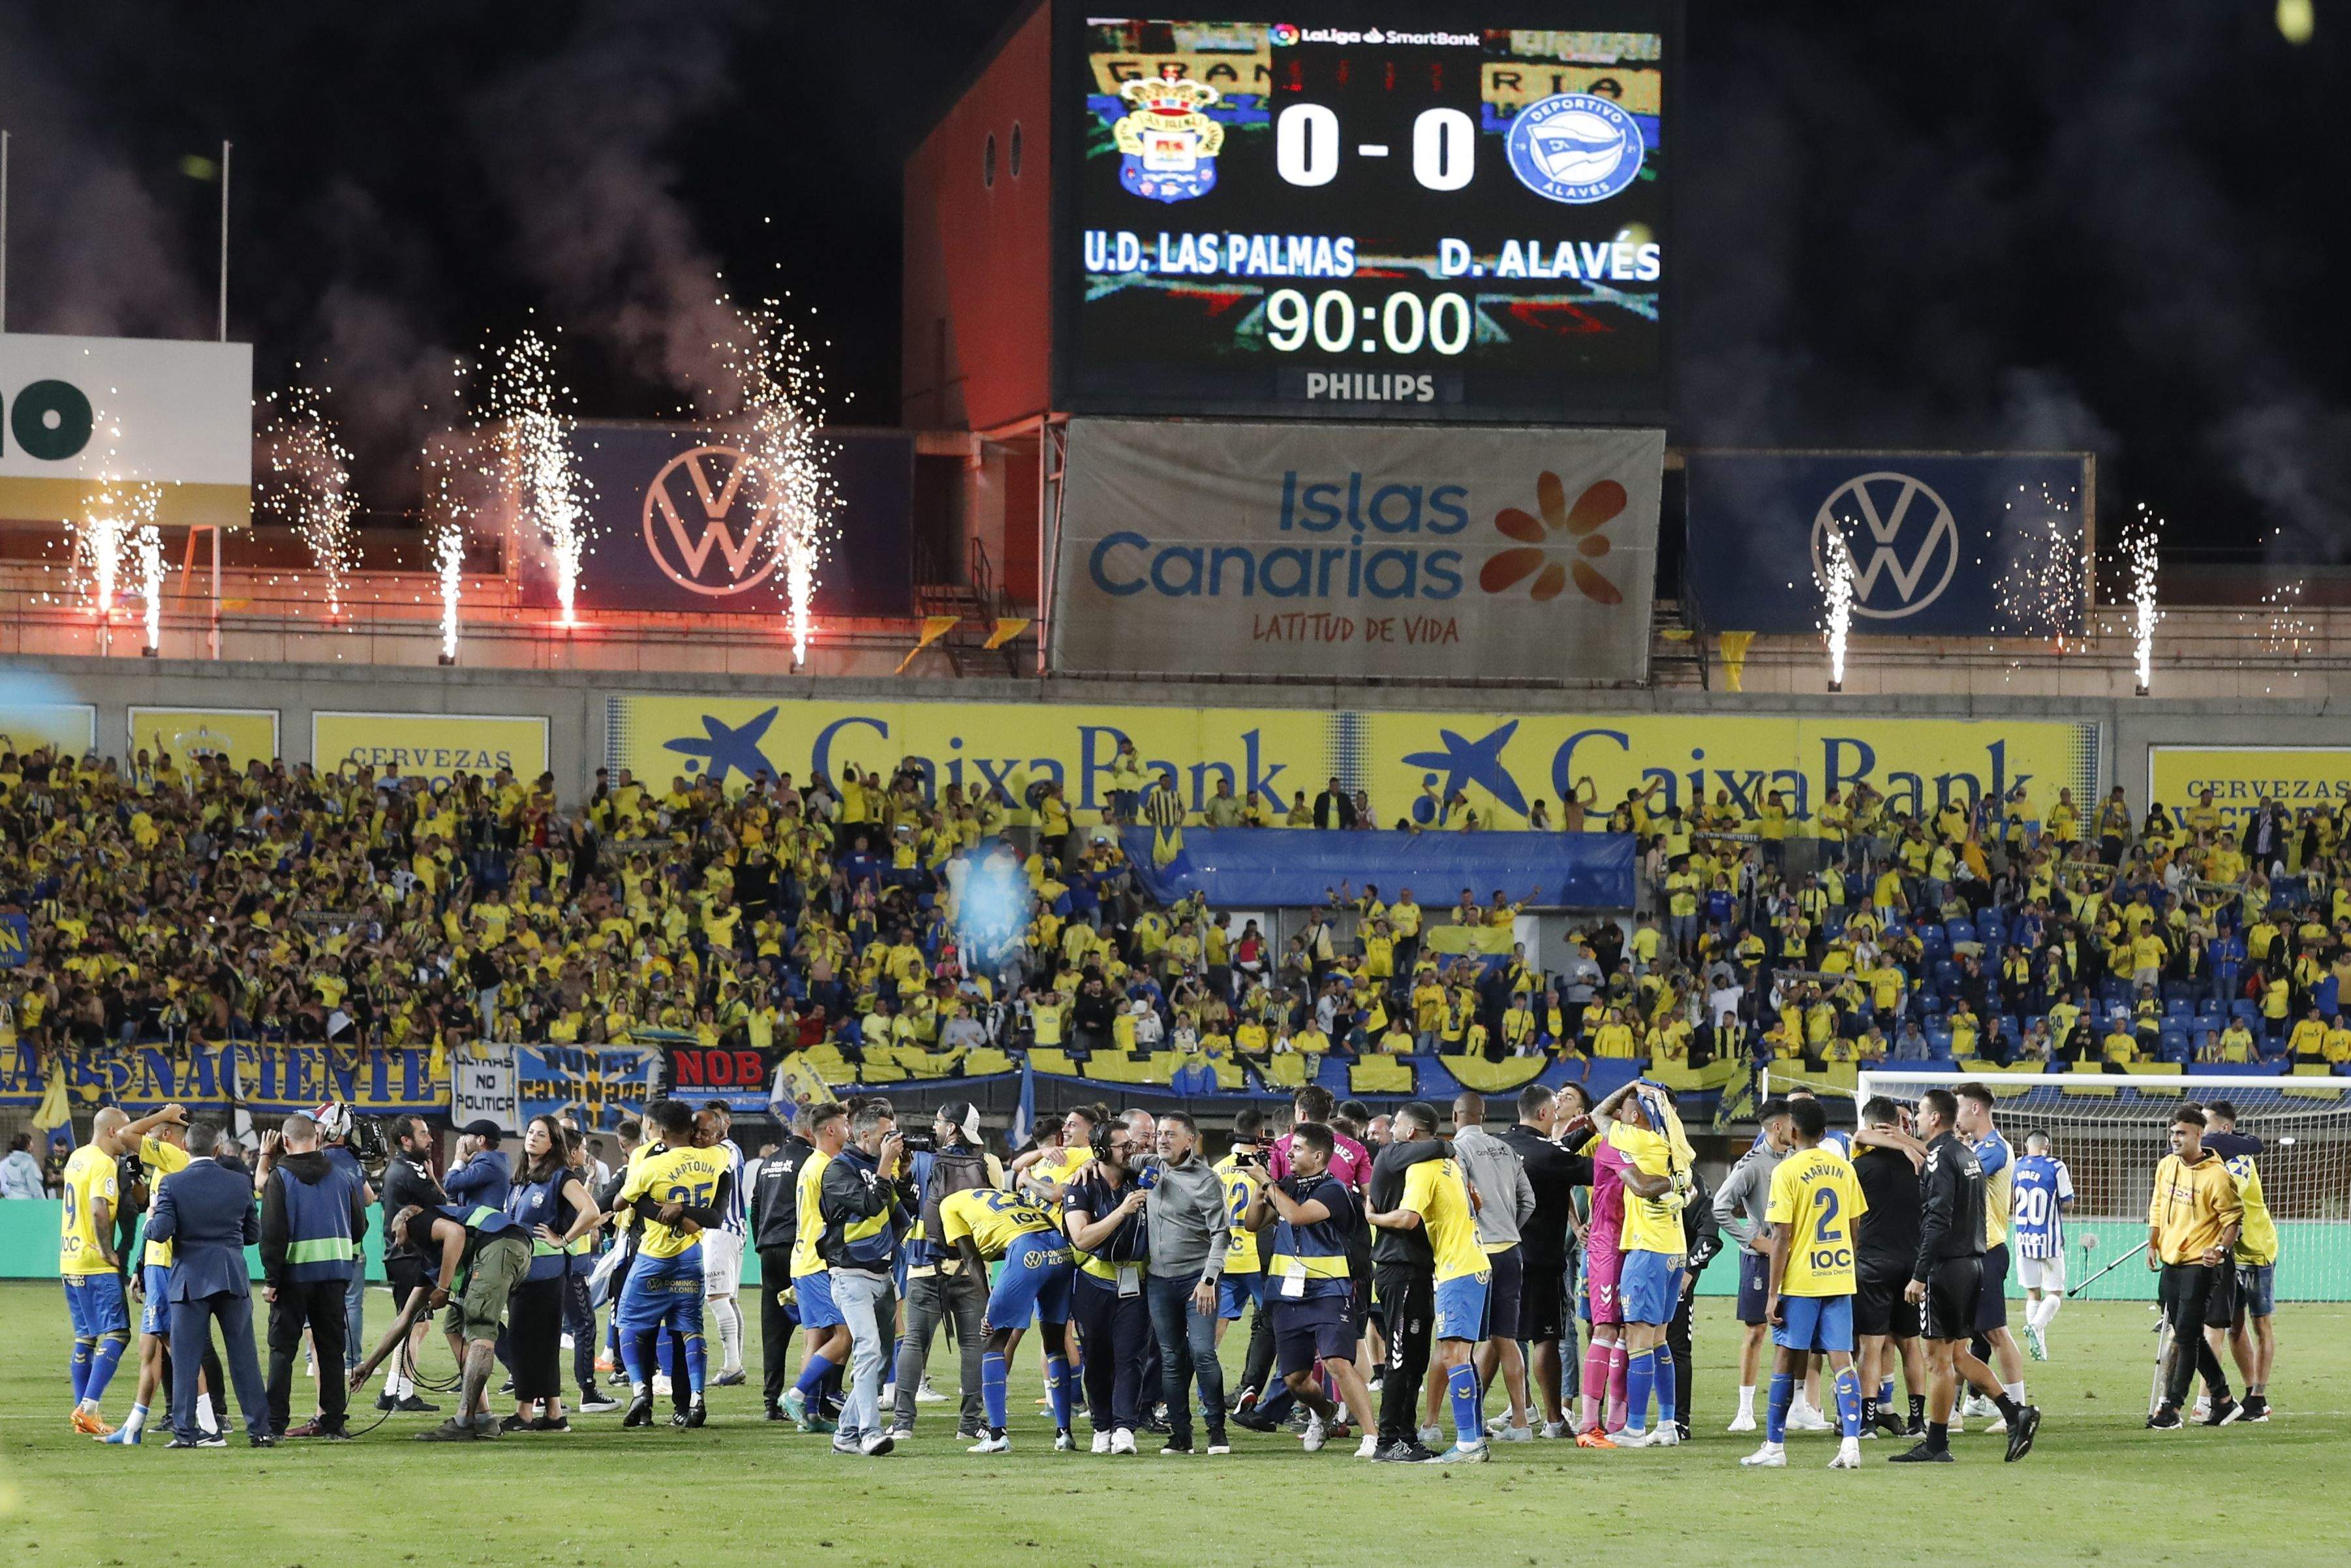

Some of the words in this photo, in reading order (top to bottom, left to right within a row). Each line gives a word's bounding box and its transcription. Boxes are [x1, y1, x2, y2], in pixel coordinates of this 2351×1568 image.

[1301, 27, 1361, 45] LaLiga
[1385, 30, 1480, 46] SmartBank
[1529, 97, 1624, 124] DEPORTIVO
[1276, 103, 1340, 187] 0
[1413, 107, 1475, 191] 0
[1541, 180, 1610, 198] ALAVÉS
[1085, 230, 1149, 272] U.D.
[1158, 232, 1219, 274] LAS
[1227, 234, 1356, 277] PALMAS
[1440, 238, 1484, 277] D.
[1496, 230, 1661, 281] ALAVÉS
[1267, 288, 1471, 355] 90:00
[1306, 372, 1435, 403] PHILIPS
[1279, 470, 1469, 535] Islas
[1088, 530, 1464, 600] Canarias
[1252, 612, 1355, 643] LATITUD
[1365, 617, 1396, 643] DE
[1403, 615, 1460, 645] VIDA
[350, 746, 512, 769] CERVEZAS
[2187, 780, 2351, 799] CERVEZAS
[476, 1074, 496, 1090] NO
[672, 1050, 764, 1086] NOB
[456, 1094, 515, 1111] POLITICA
[668, 1161, 715, 1182] KAPTOUM
[1800, 1164, 1844, 1184] MARVIN
[65, 1182, 76, 1230] 9
[1813, 1187, 1843, 1245] 2
[2015, 1186, 2048, 1226] 20
[1809, 1248, 1851, 1269] IOC
